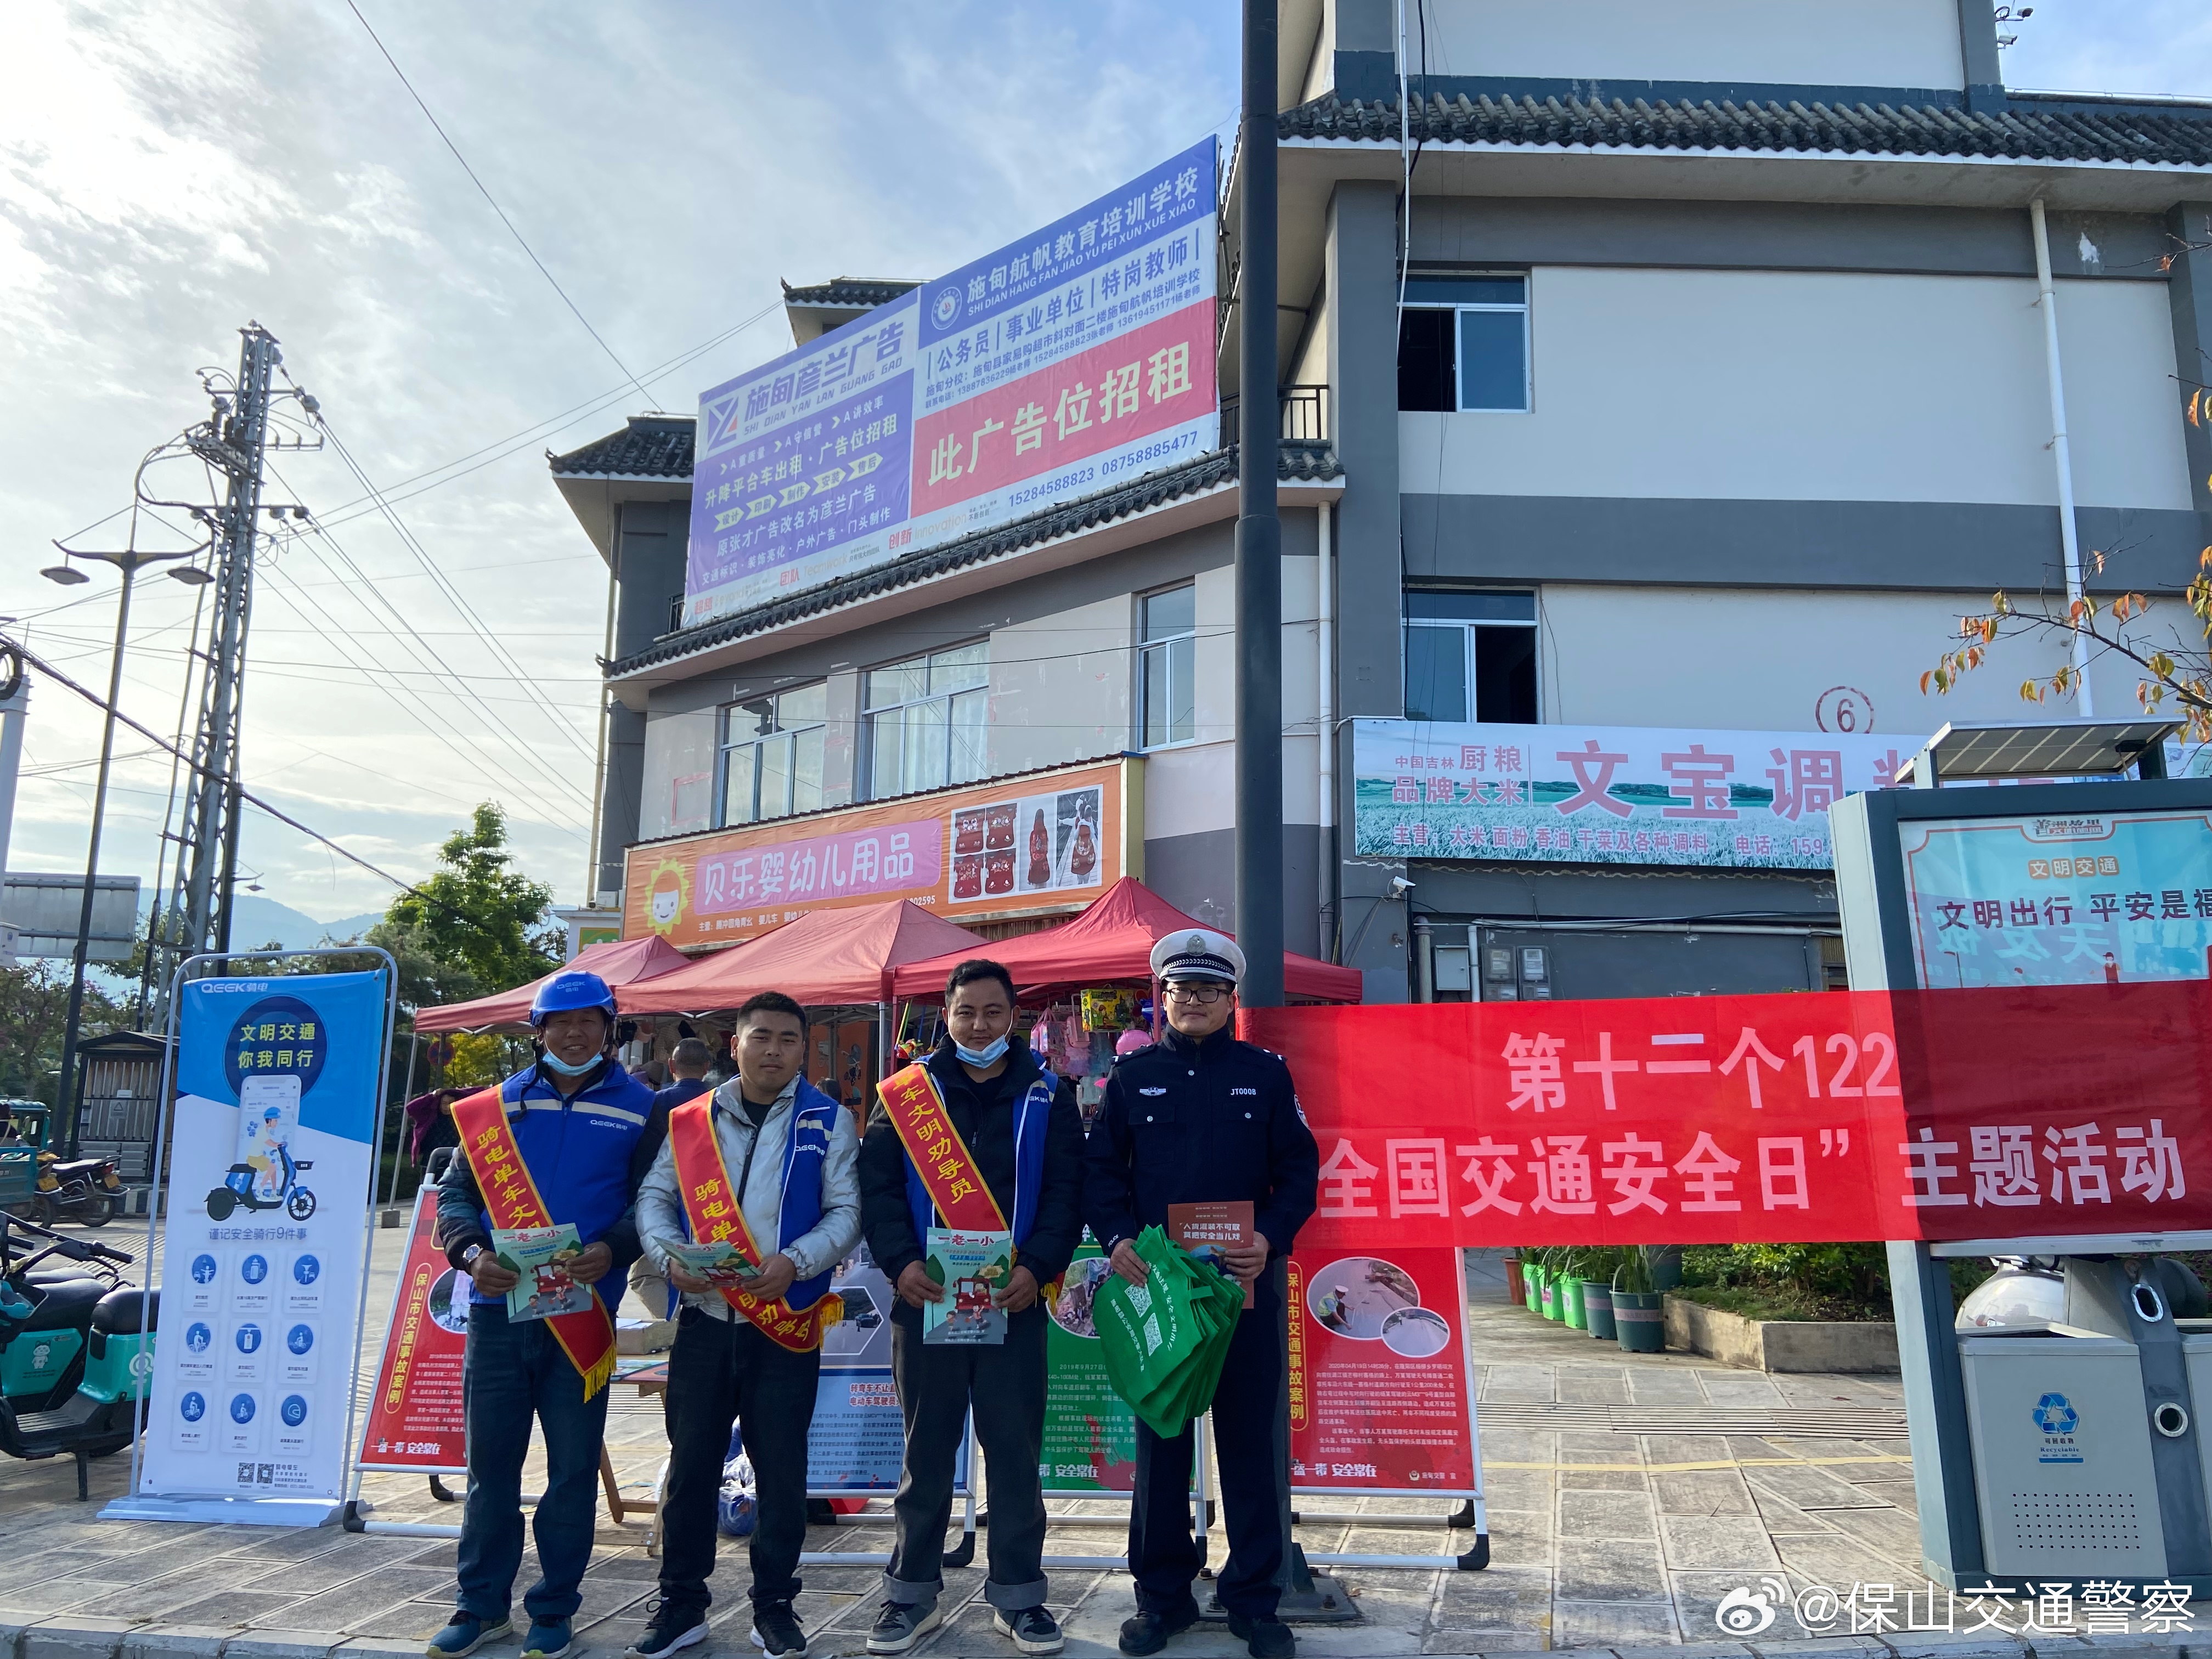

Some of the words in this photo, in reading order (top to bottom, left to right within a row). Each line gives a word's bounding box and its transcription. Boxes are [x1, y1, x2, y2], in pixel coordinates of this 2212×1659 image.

[967, 167, 1198, 304] 施甸航帆教育培训学校
[968, 304, 983, 317] SHI
[985, 292, 1008, 309] DIAN
[1009, 278, 1037, 298] HANG
[1039, 267, 1058, 285] FAN
[1060, 255, 1084, 275] JIAO
[1085, 246, 1099, 262] YU
[1101, 238, 1116, 256] PEI
[1119, 226, 1142, 245] XUN
[1143, 215, 1165, 233] XUE
[1168, 198, 1195, 221] XIAO
[938, 329, 989, 373] 公务员
[1006, 286, 1084, 343] 事业单位
[1102, 235, 1188, 301] 特岗教师
[744, 321, 904, 422] 施甸彦兰广告
[744, 423, 758, 436] SHI
[765, 410, 786, 428] DIAN
[792, 399, 811, 417] YAN
[816, 389, 834, 404] LAN
[840, 370, 874, 394] GUANG
[882, 357, 902, 374] GAO
[928, 341, 1192, 487] 此广告位招租
[722, 512, 740, 526] 设计
[754, 496, 771, 511] 印刷
[787, 485, 805, 501] 制作
[822, 472, 840, 488] 安装
[857, 457, 877, 473] 售后
[1008, 467, 1094, 507] 15284588823
[1102, 431, 1198, 476] 08758885477
[716, 483, 876, 558] 原张才广告改名为彦兰广告
[889, 527, 912, 550] 创新
[915, 513, 967, 540] Innovation
[780, 567, 800, 586] 团队
[804, 552, 848, 578] Teamwork
[1837, 698, 1855, 732] 6
[1392, 775, 1524, 806] 品牌大米
[1395, 755, 1455, 770] 中国吉林
[1459, 744, 1523, 774] 厨粮
[704, 832, 915, 906] 贝乐婴幼儿用品
[2030, 856, 2119, 878] 文明交通
[1937, 896, 2073, 932] 文明出行
[238, 1049, 313, 1070] 你我同行
[240, 1023, 315, 1042] 文明交通
[1500, 1026, 1900, 1113] 第十二个122
[1898, 1119, 2186, 1208] 主题活动
[209, 1227, 307, 1240] 谨记安全骑行9件事
[503, 1229, 562, 1243] 一老一小
[938, 1234, 995, 1246] 一老一小
[388, 1273, 428, 1403] 保山市交通事故案例
